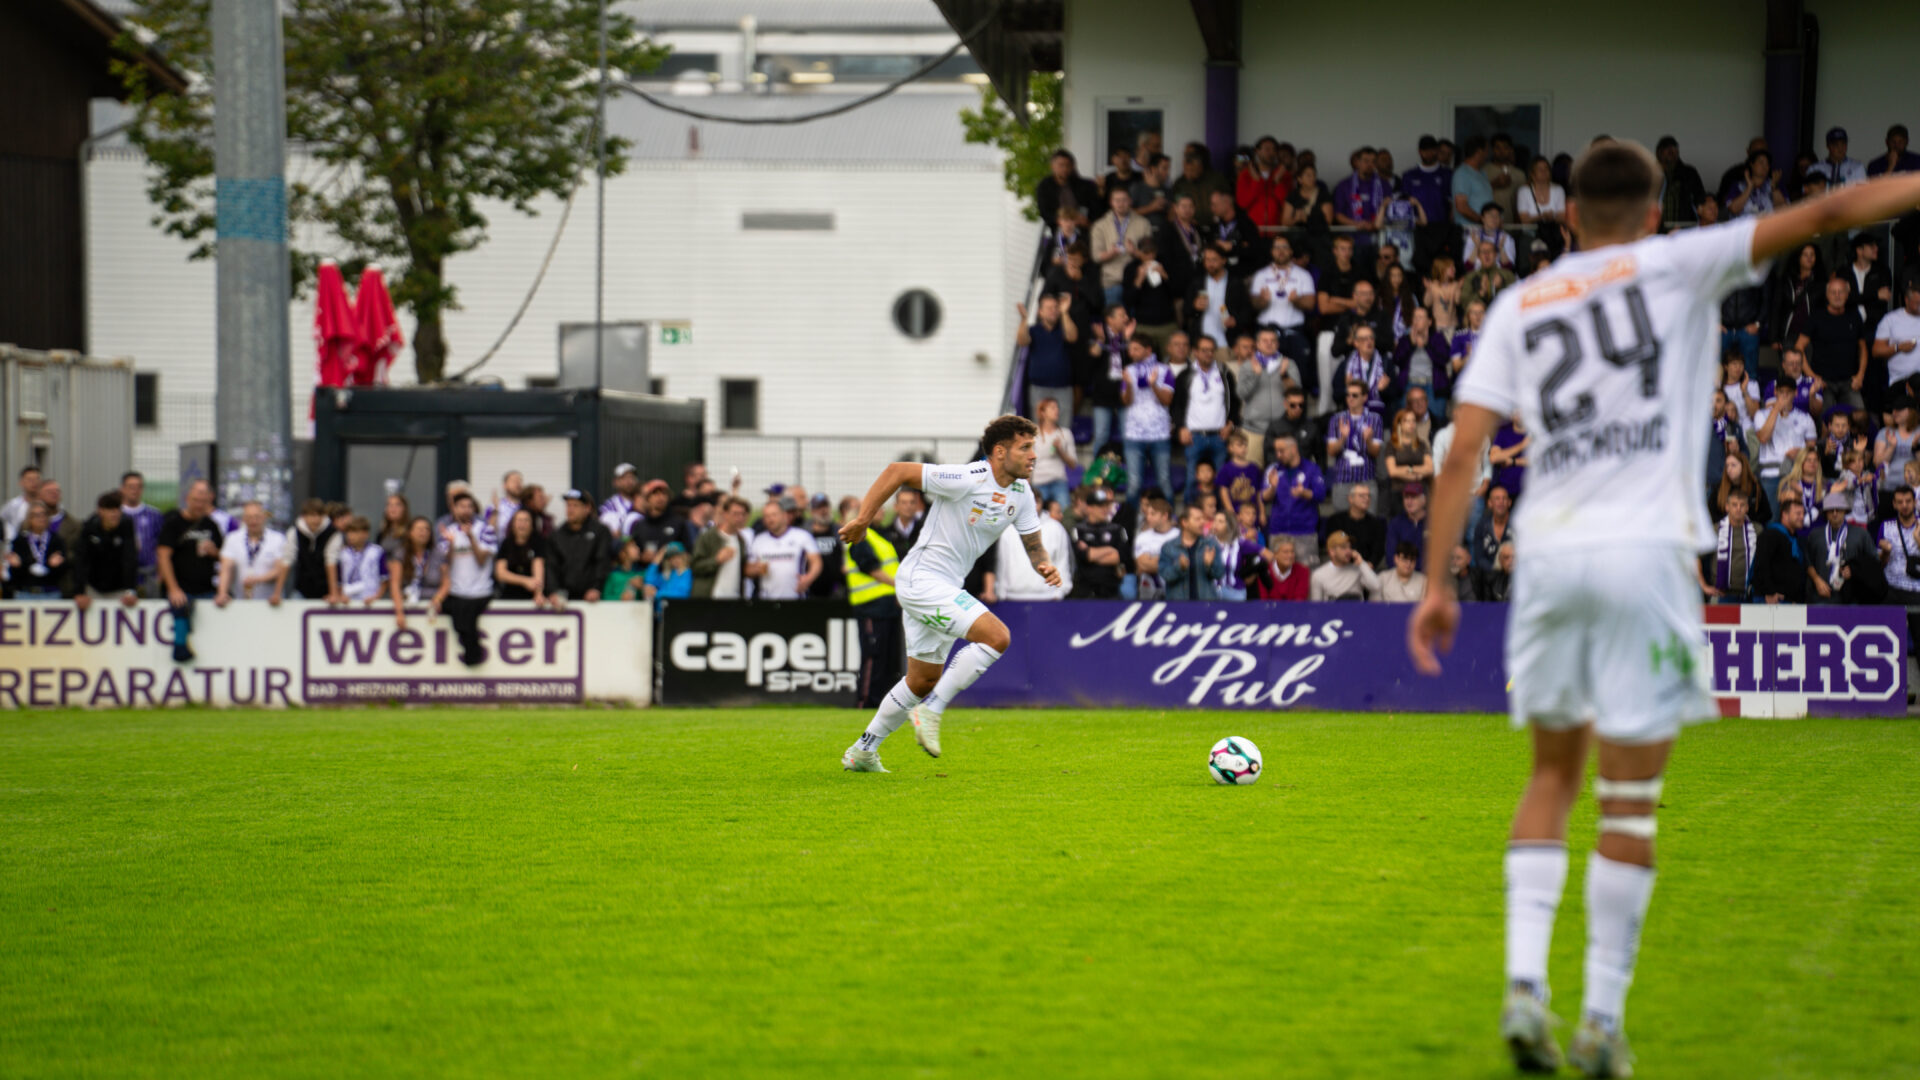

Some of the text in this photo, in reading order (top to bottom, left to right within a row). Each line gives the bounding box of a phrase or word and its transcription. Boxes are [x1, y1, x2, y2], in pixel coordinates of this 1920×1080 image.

[1524, 284, 1665, 433] 24
[765, 671, 861, 692] SPOR
[1187, 649, 1325, 706] Pub
[1702, 624, 1900, 702] HERS
[0, 668, 293, 706] REPARATUR
[307, 683, 338, 697] BAD
[349, 683, 409, 697] HEIZUNG
[420, 683, 487, 697] PLANUNG
[497, 683, 577, 697] REPARATUR
